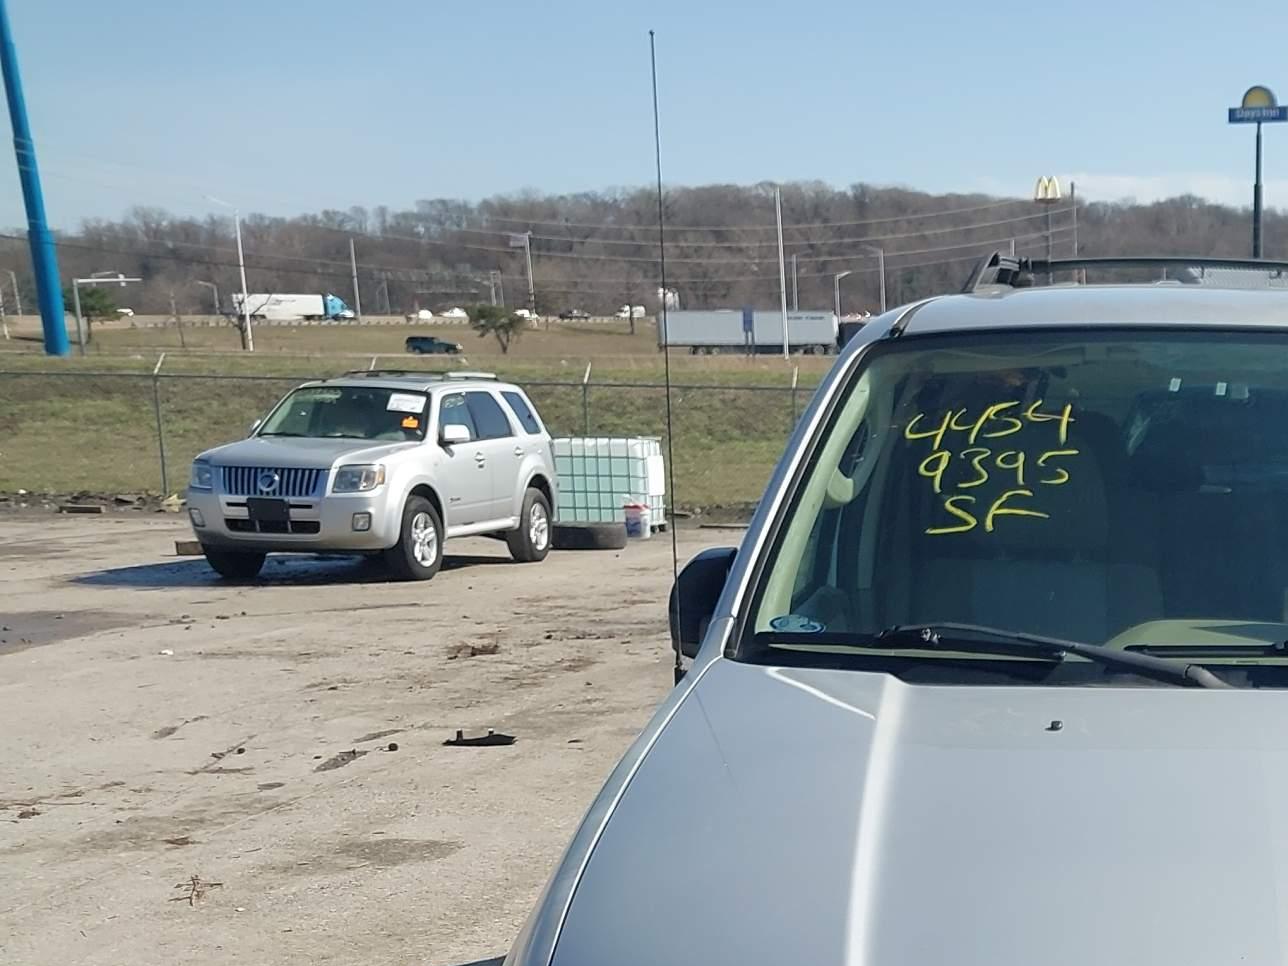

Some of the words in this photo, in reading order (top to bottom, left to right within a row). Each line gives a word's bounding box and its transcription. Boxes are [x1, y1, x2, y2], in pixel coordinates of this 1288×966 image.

[904, 399, 1075, 451] 4454
[918, 447, 1080, 494] 9395
[924, 489, 1050, 535] SF
